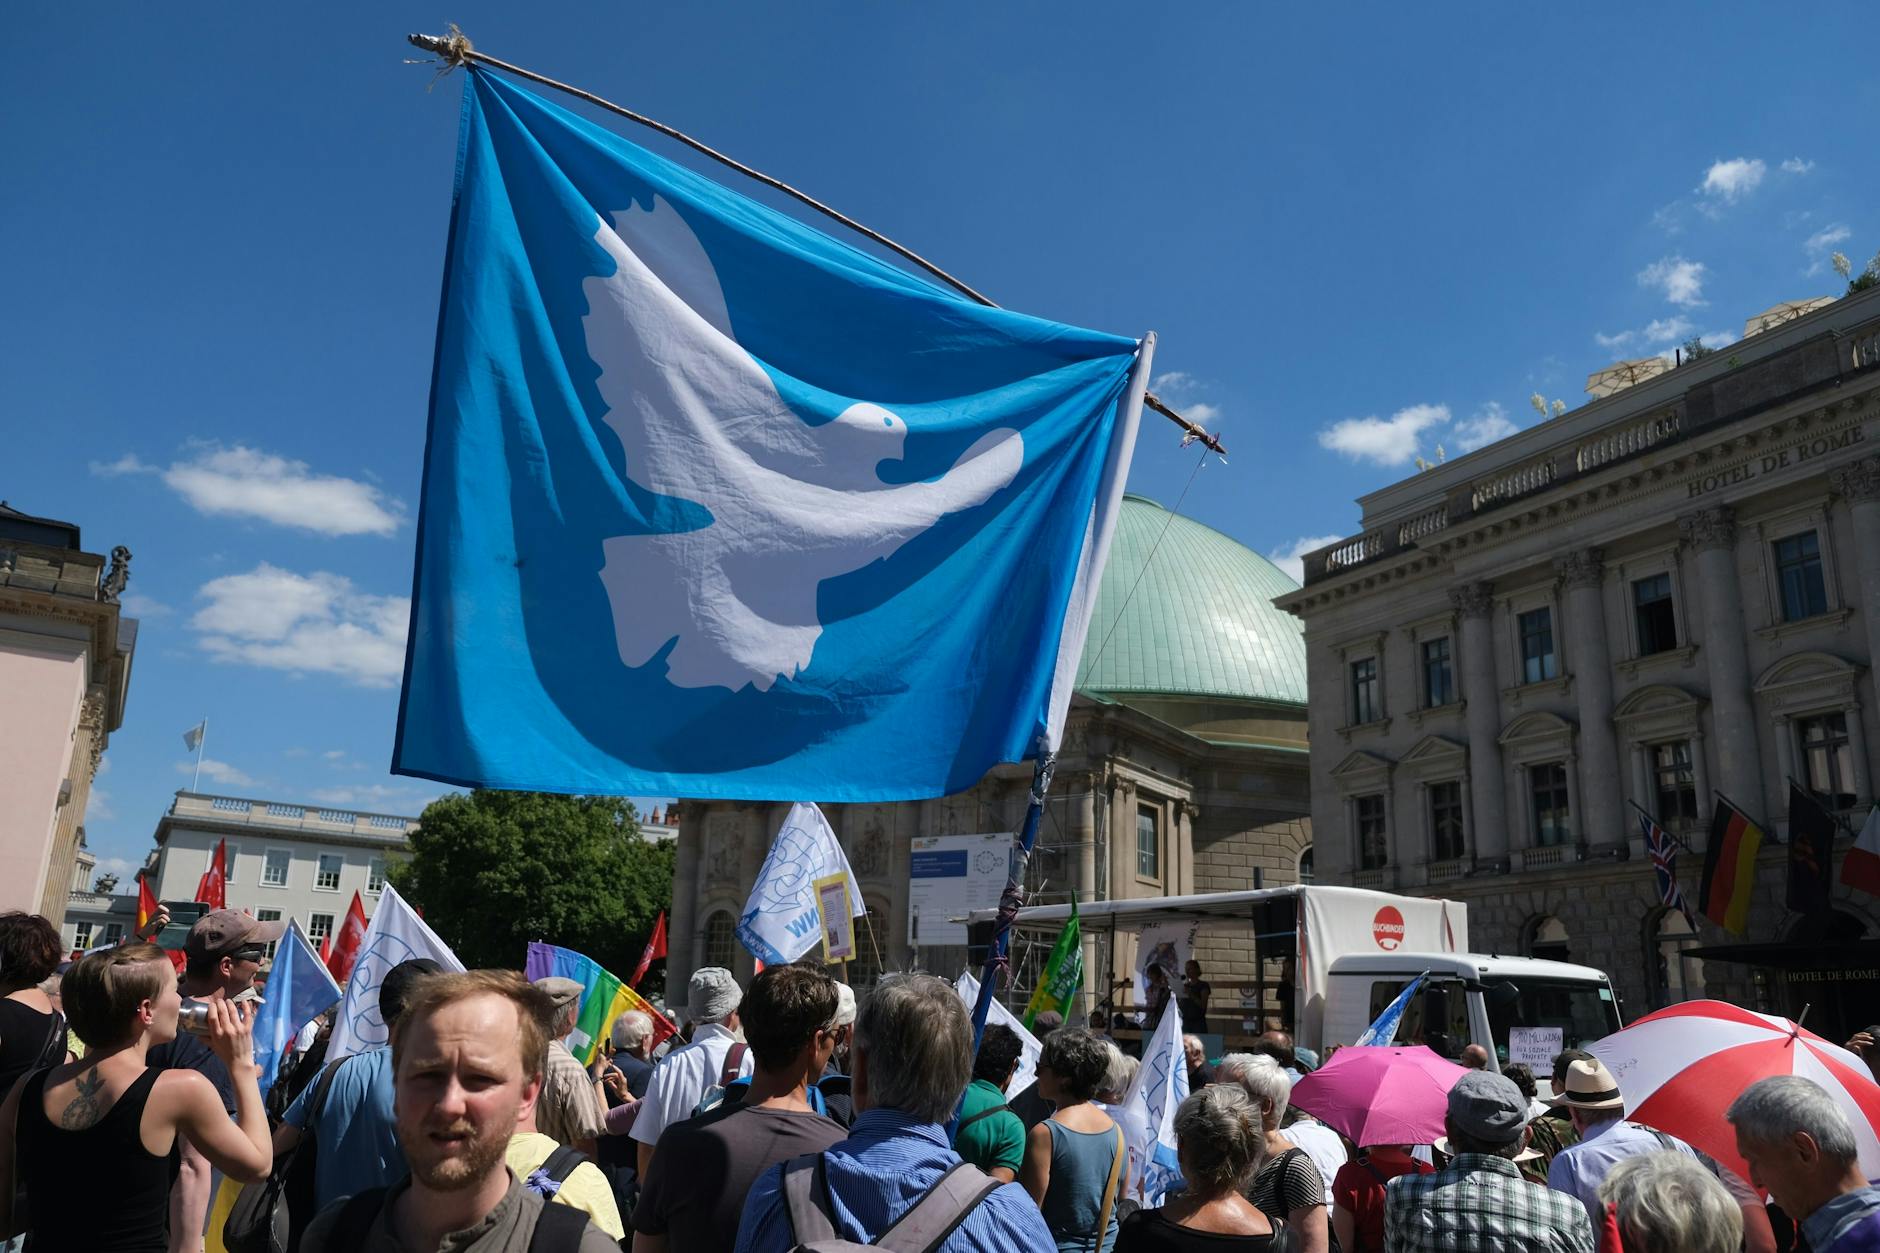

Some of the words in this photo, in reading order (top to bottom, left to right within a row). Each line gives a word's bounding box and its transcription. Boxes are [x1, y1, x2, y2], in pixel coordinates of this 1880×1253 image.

[1687, 466, 1756, 499] HOTEL
[1761, 452, 1791, 474] DE
[1798, 426, 1865, 462] ROME
[1788, 971, 1824, 982] HOTEL
[1826, 970, 1843, 981] DE
[1845, 968, 1880, 981] ROME
